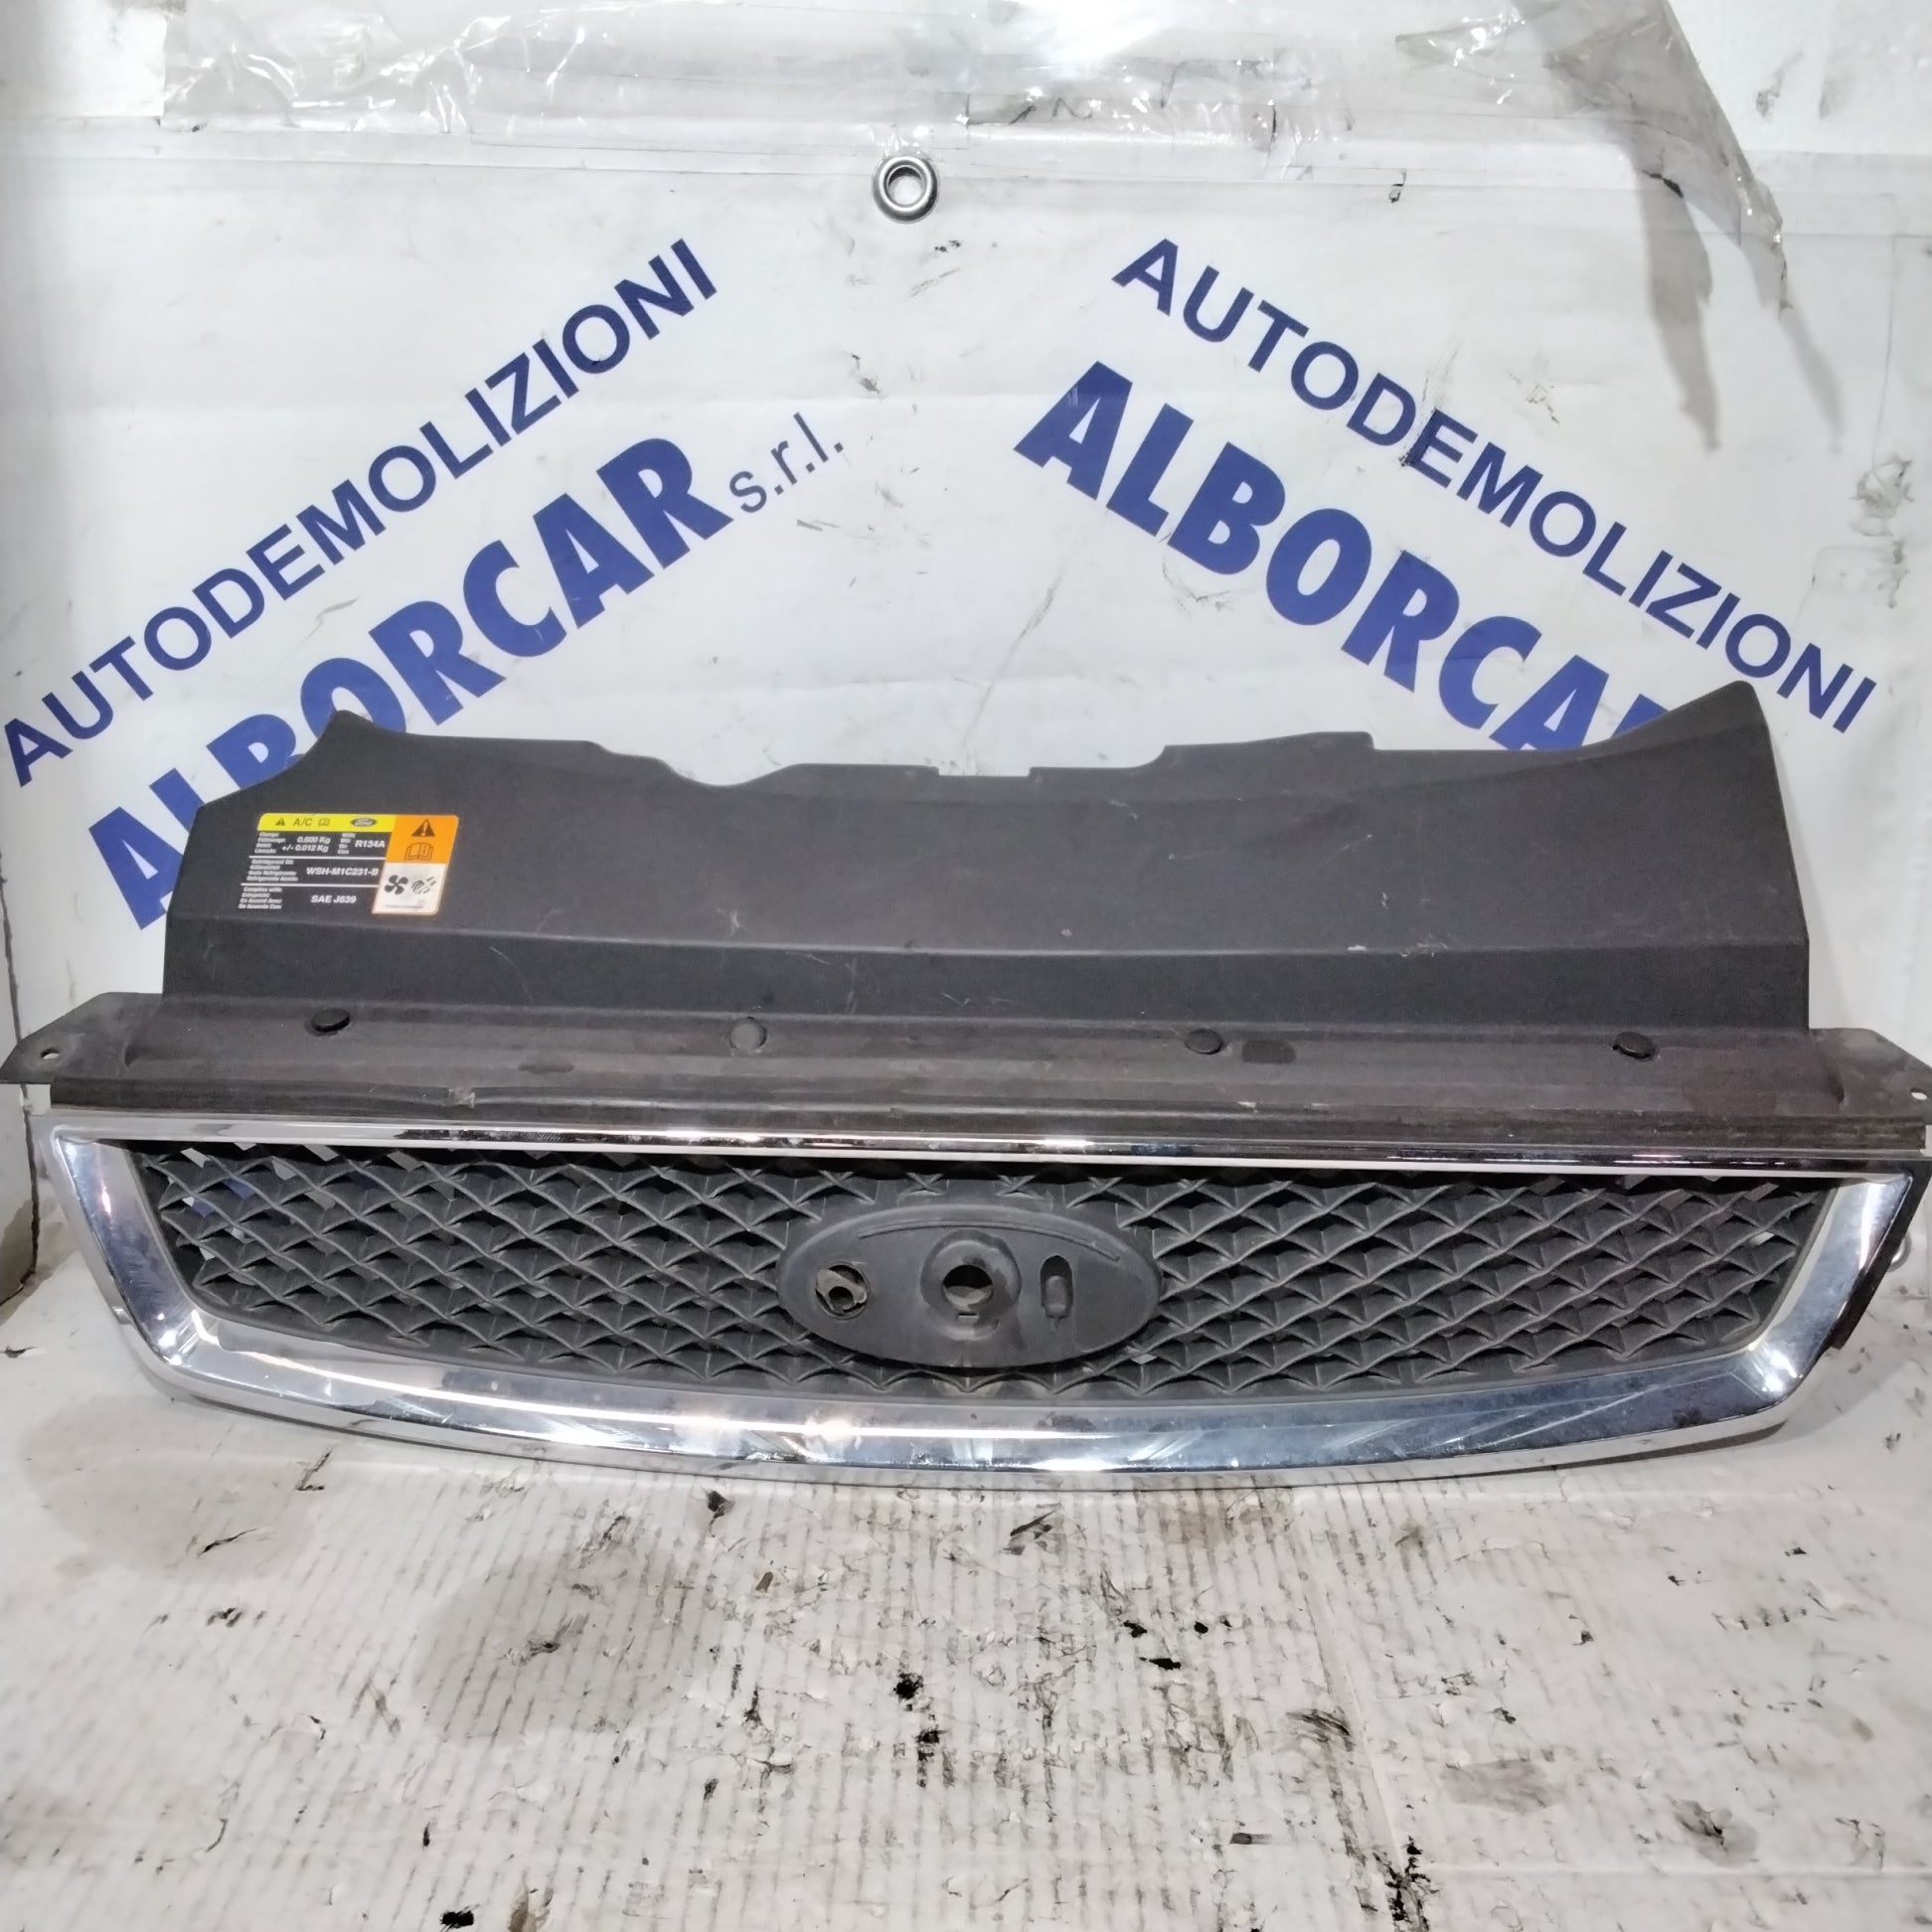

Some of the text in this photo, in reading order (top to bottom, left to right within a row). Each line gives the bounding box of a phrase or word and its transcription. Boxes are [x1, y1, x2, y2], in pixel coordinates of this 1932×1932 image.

[3, 239, 718, 787] AUTODEMOLIZIONI
[729, 412, 844, 513] s.r.l.
[1111, 238, 1876, 733] AUTODEMOLIZIONI
[1012, 361, 1670, 751] ALBORCA
[293, 817, 313, 827] A/C
[355, 839, 386, 848] R134A
[310, 894, 333, 903] SAE
